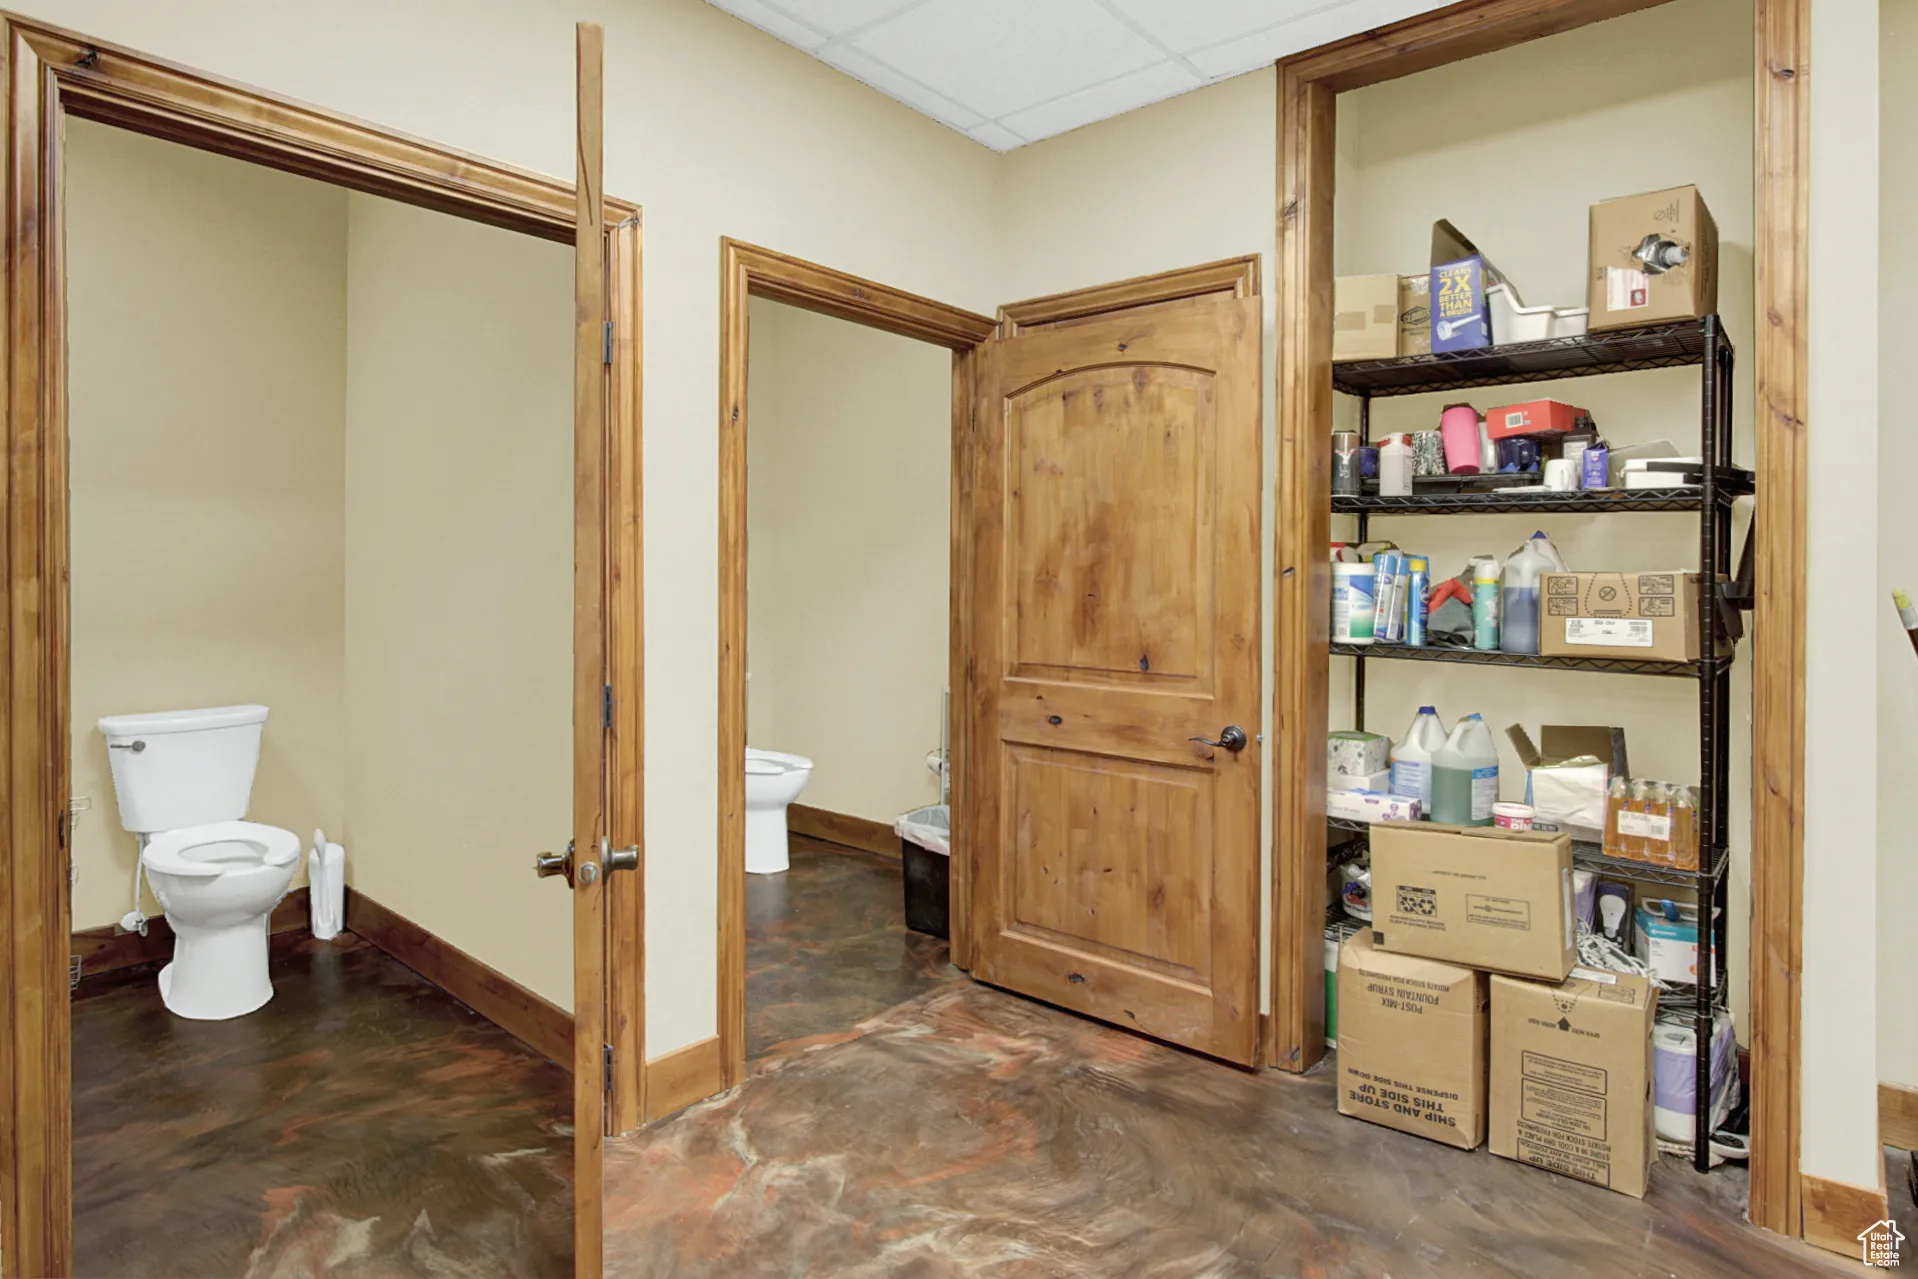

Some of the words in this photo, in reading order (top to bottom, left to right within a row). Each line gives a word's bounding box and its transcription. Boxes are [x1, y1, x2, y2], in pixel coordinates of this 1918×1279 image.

[1439, 275, 1472, 295] 2X
[1439, 291, 1472, 303] BETTER
[1439, 299, 1472, 312] THAN
[1392, 976, 1404, 984] FOR
[1406, 978, 1426, 988] STOCK
[1366, 983, 1395, 996] SYRUP
[1427, 982, 1450, 993] ROTATE
[1396, 988, 1439, 1005] FOUNTAIN
[1382, 997, 1423, 1015] POST-MIX
[1348, 1067, 1371, 1080] DOWN
[1373, 1075, 1392, 1086] SIDE
[1393, 1080, 1413, 1091] THIS
[1359, 1084, 1376, 1094] UP
[1416, 1086, 1458, 1101] DISPENSE
[1349, 1090, 1390, 1110] STORE
[1380, 1088, 1409, 1104] SIDE
[1393, 1104, 1421, 1118] AND
[1413, 1098, 1444, 1113] THIS
[1424, 1112, 1456, 1128] SHIP
[1524, 1132, 1542, 1143] PLACE
[1544, 1138, 1556, 1146] DRY
[1551, 1132, 1564, 1140] FOR
[1565, 1134, 1586, 1145] STOCK
[1556, 1140, 1574, 1152] COOL
[1587, 1140, 1612, 1152] ROTATE
[1528, 1156, 1544, 1165] UP
[1590, 1150, 1610, 1161] STORE
[1546, 1160, 1570, 1172] SIDE
[1572, 1168, 1596, 1180] THIS
